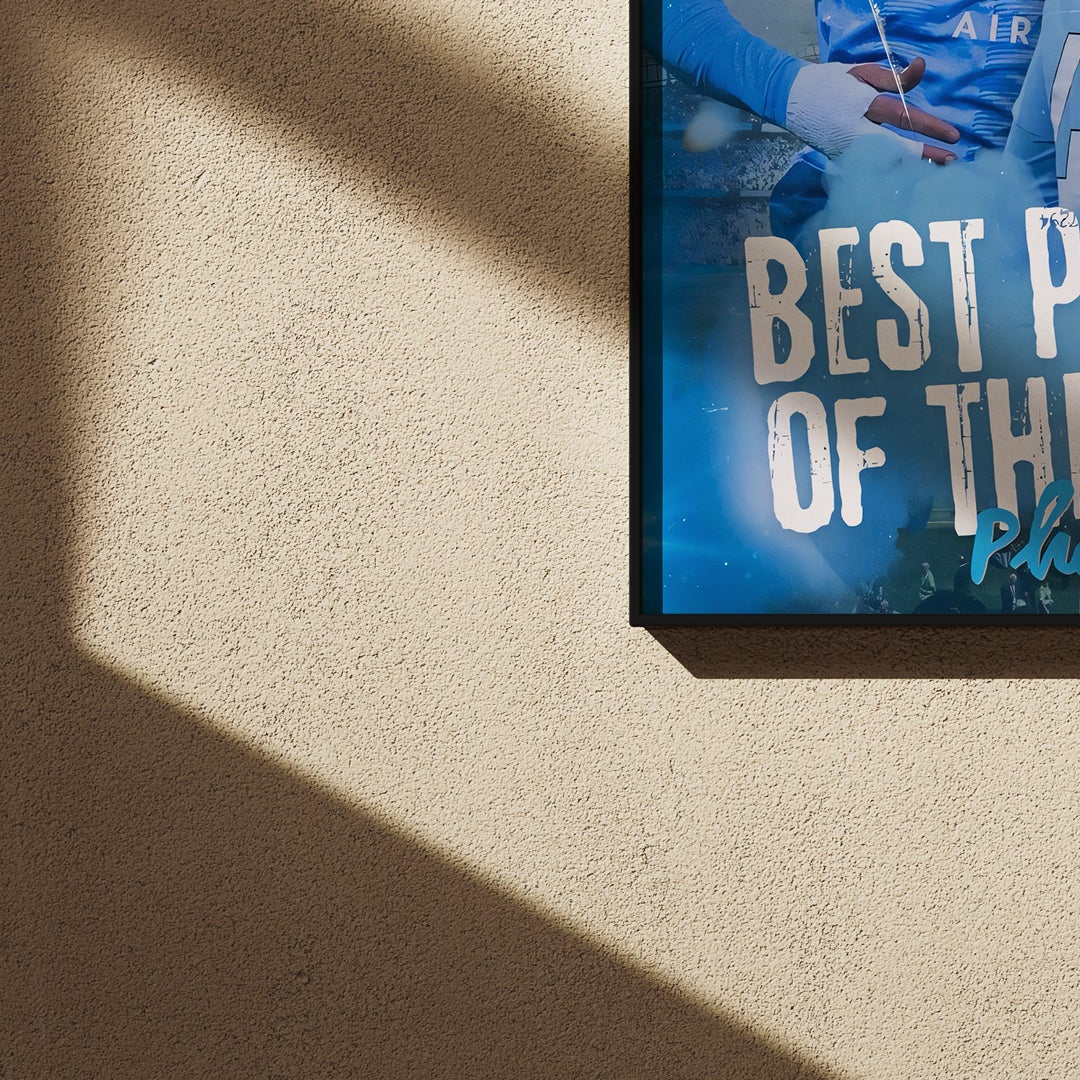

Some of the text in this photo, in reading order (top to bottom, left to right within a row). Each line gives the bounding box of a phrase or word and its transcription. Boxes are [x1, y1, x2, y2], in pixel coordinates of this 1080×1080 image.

[952, 11, 1029, 46] AIR
[744, 218, 984, 386] BEST
[767, 391, 887, 534] OF
